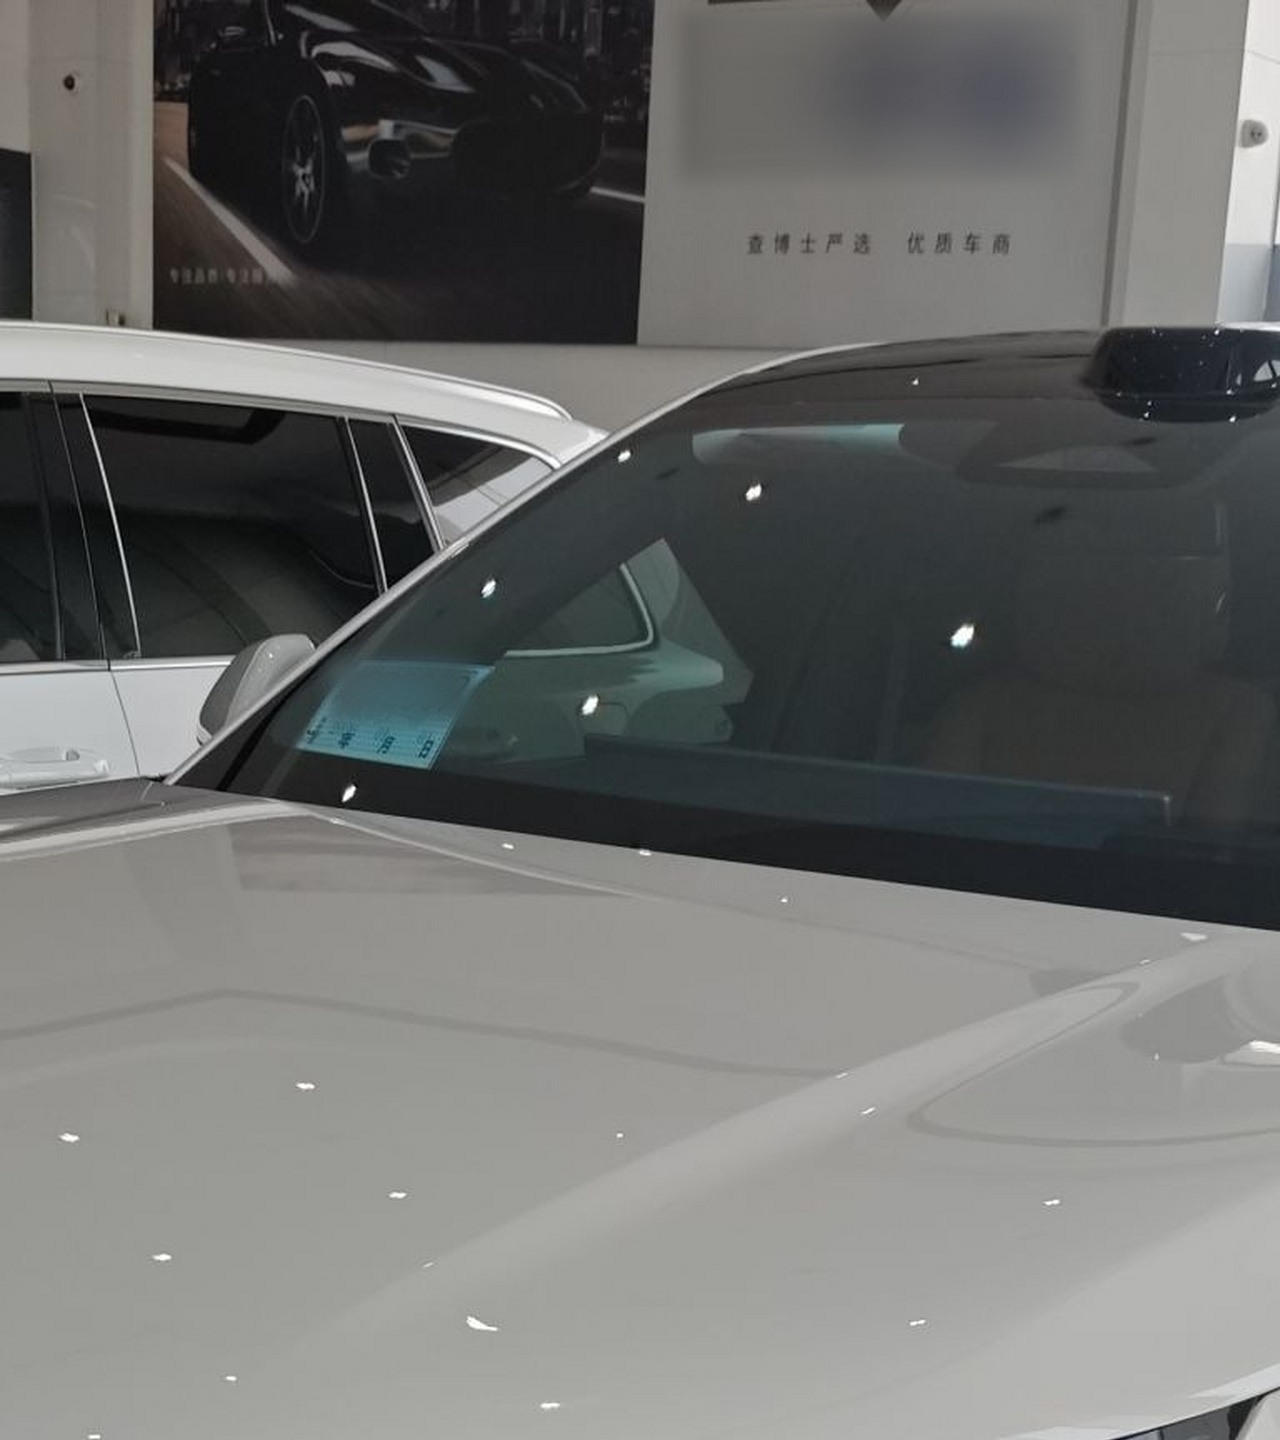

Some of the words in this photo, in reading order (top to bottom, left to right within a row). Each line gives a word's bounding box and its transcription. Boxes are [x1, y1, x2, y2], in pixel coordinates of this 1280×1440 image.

[747, 232, 870, 254] 查博士严选
[907, 231, 1011, 254] 优质车商
